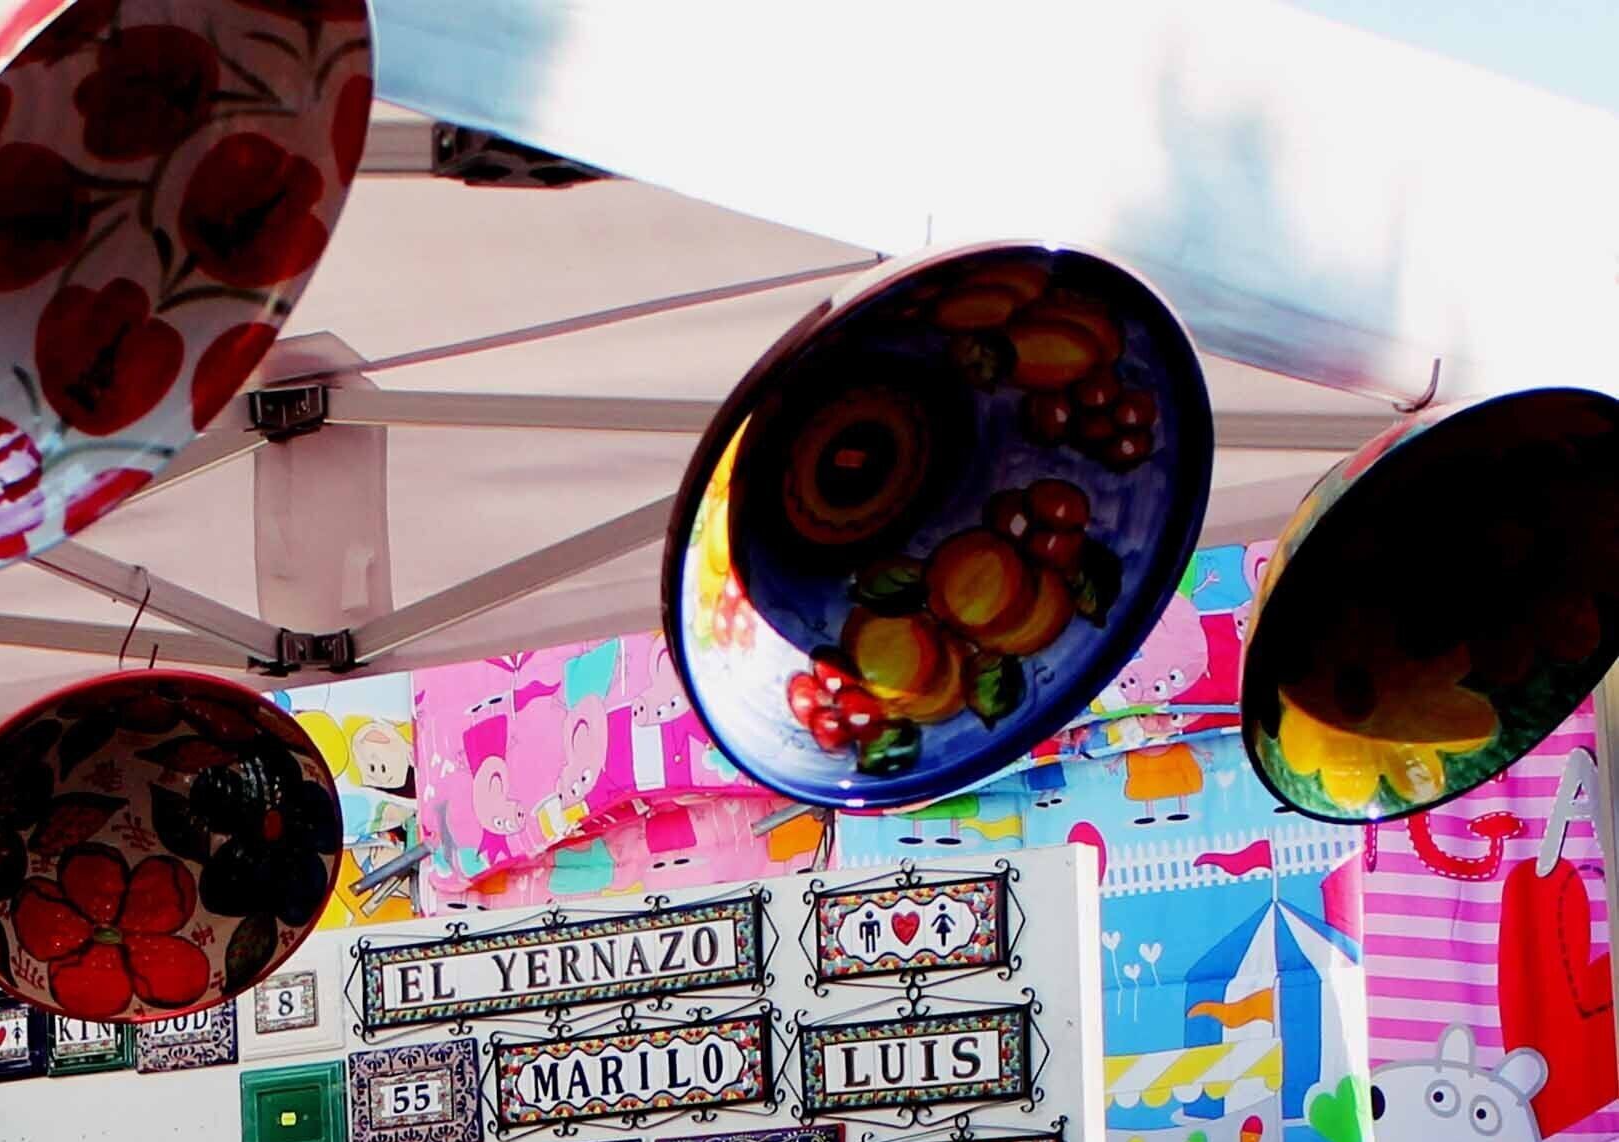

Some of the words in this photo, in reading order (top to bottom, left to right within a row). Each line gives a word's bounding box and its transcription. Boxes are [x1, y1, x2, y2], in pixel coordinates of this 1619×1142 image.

[400, 966, 456, 1003] EL
[493, 926, 720, 992] YERNAZO
[277, 992, 294, 1016] 8
[58, 1016, 112, 1042] KIN
[533, 1047, 725, 1103] MARILO
[843, 1038, 982, 1088] LUIS
[393, 1083, 431, 1113] 55
